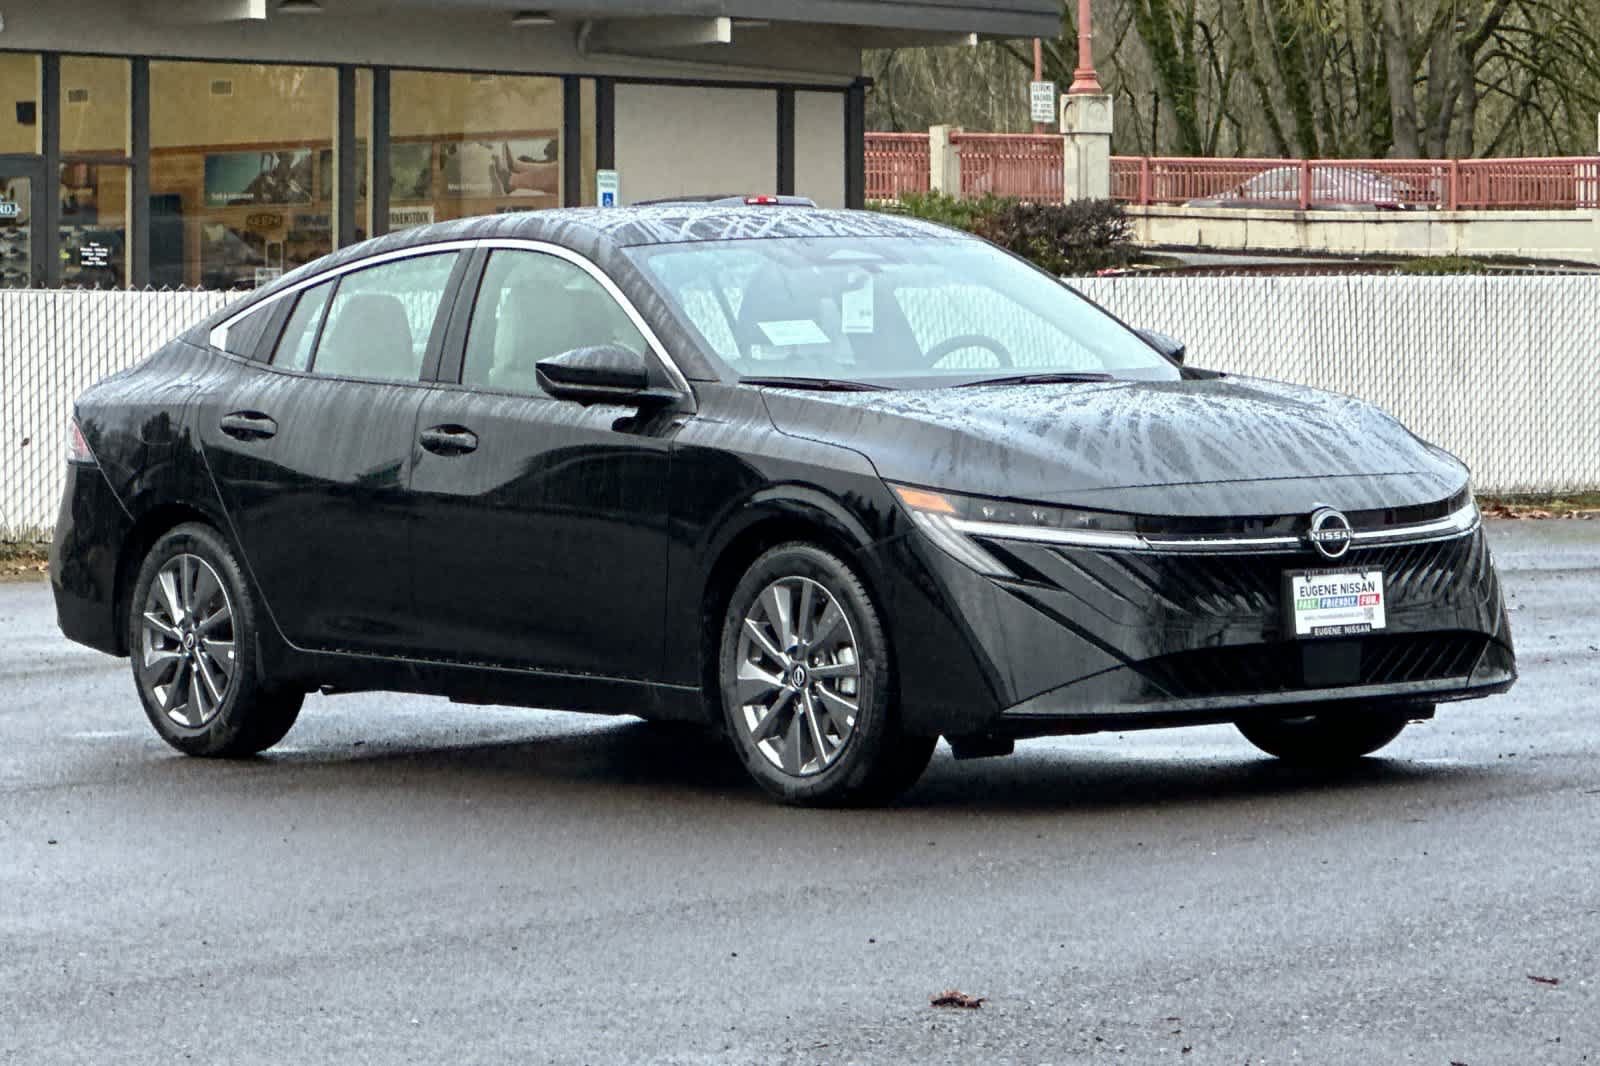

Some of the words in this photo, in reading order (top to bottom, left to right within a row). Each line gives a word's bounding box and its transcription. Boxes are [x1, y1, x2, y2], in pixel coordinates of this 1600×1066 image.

[1310, 529, 1354, 542] NISSAN
[1299, 583, 1338, 598] EUGENE
[1340, 581, 1376, 595] NISSAN
[1314, 626, 1342, 636] EUGENE
[1344, 624, 1371, 634] NISSAN
